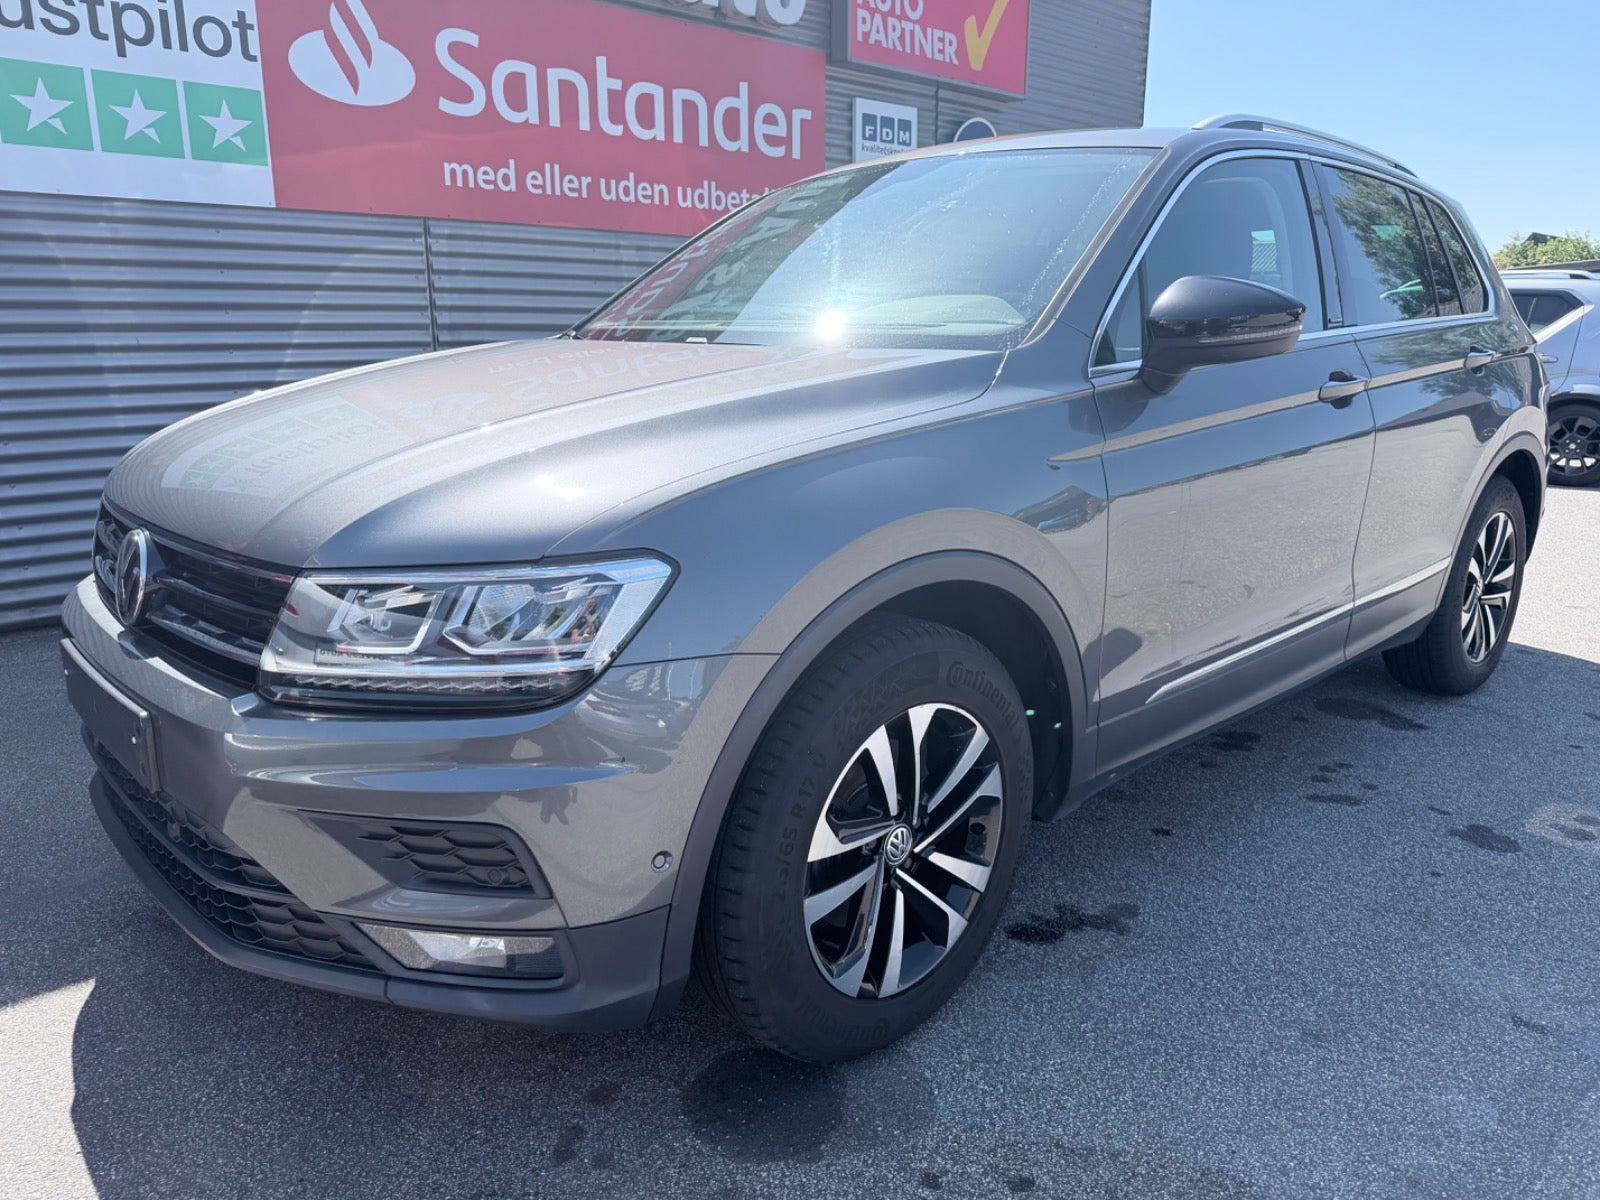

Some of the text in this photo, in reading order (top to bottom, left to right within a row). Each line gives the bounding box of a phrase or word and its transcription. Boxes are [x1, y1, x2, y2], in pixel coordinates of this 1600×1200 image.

[856, 8, 959, 65] PARTNER
[435, 27, 812, 159] Santander
[864, 123, 911, 144] FDM
[443, 159, 517, 192] med
[525, 162, 592, 198] eller
[599, 172, 669, 206] uden
